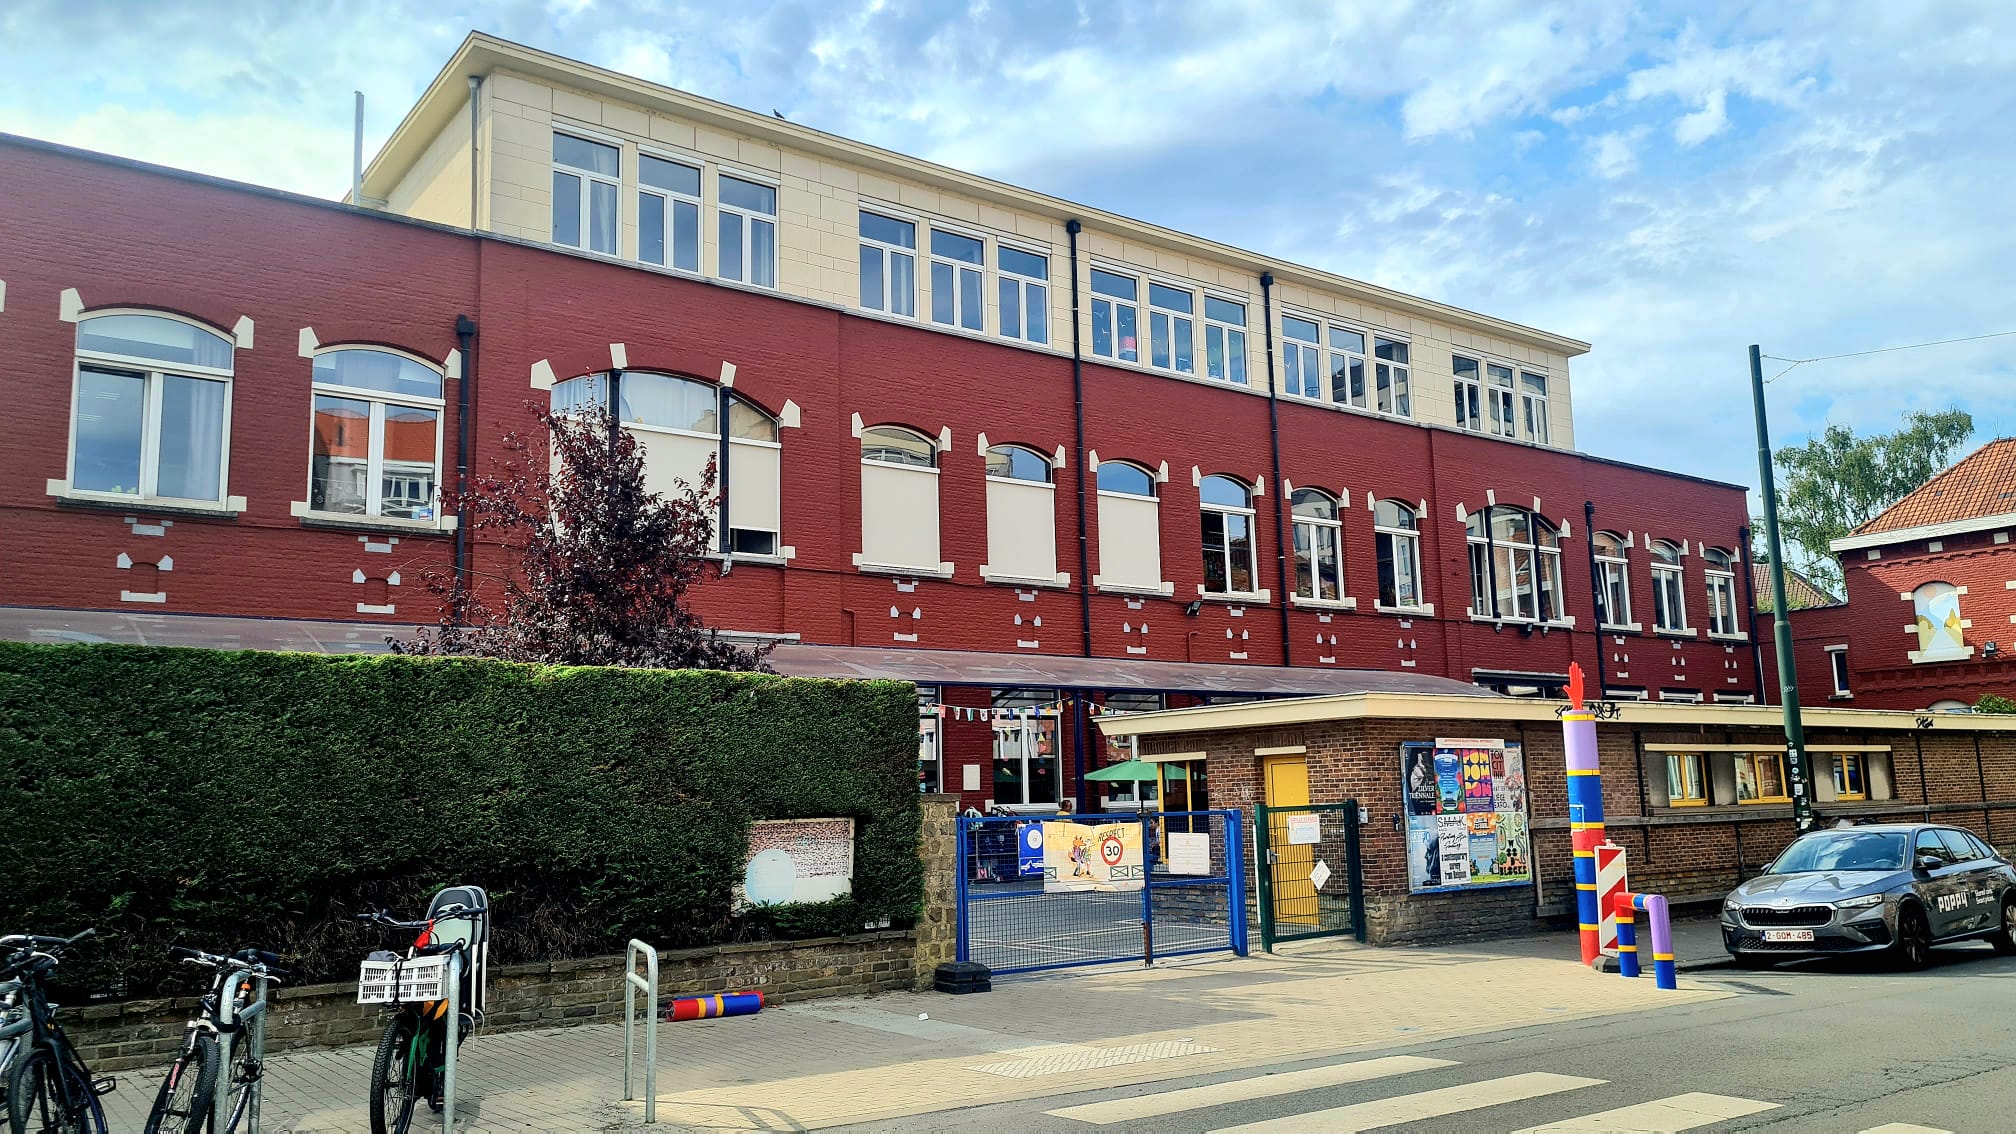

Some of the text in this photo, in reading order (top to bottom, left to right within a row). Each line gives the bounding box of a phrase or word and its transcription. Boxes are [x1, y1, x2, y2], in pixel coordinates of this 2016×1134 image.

[1463, 749, 1489, 764] POM
[1464, 764, 1491, 781] POM
[1465, 781, 1492, 797] POM
[1097, 827, 1125, 843] RESPECT
[1105, 845, 1120, 856] 30
[1937, 892, 1968, 913] POPPY
